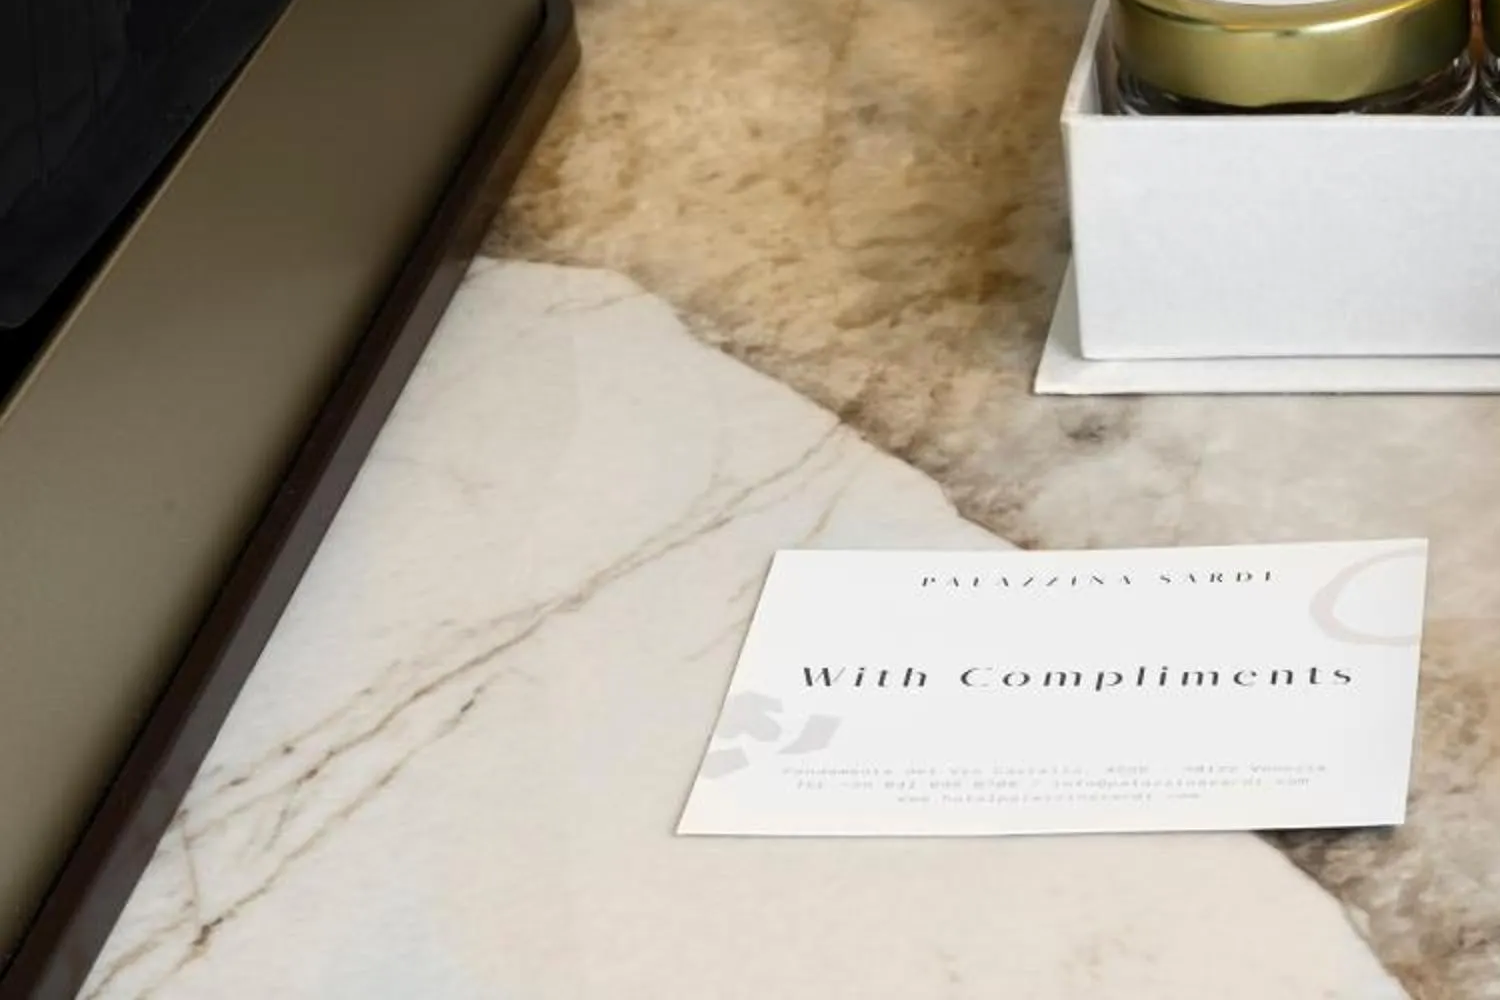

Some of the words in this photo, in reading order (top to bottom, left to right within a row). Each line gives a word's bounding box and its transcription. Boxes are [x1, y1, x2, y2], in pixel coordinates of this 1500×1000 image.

[921, 575, 1132, 588] PALAZZINA
[1159, 570, 1273, 585] SARDI
[802, 665, 928, 688] With
[959, 664, 1354, 692] Compliments
